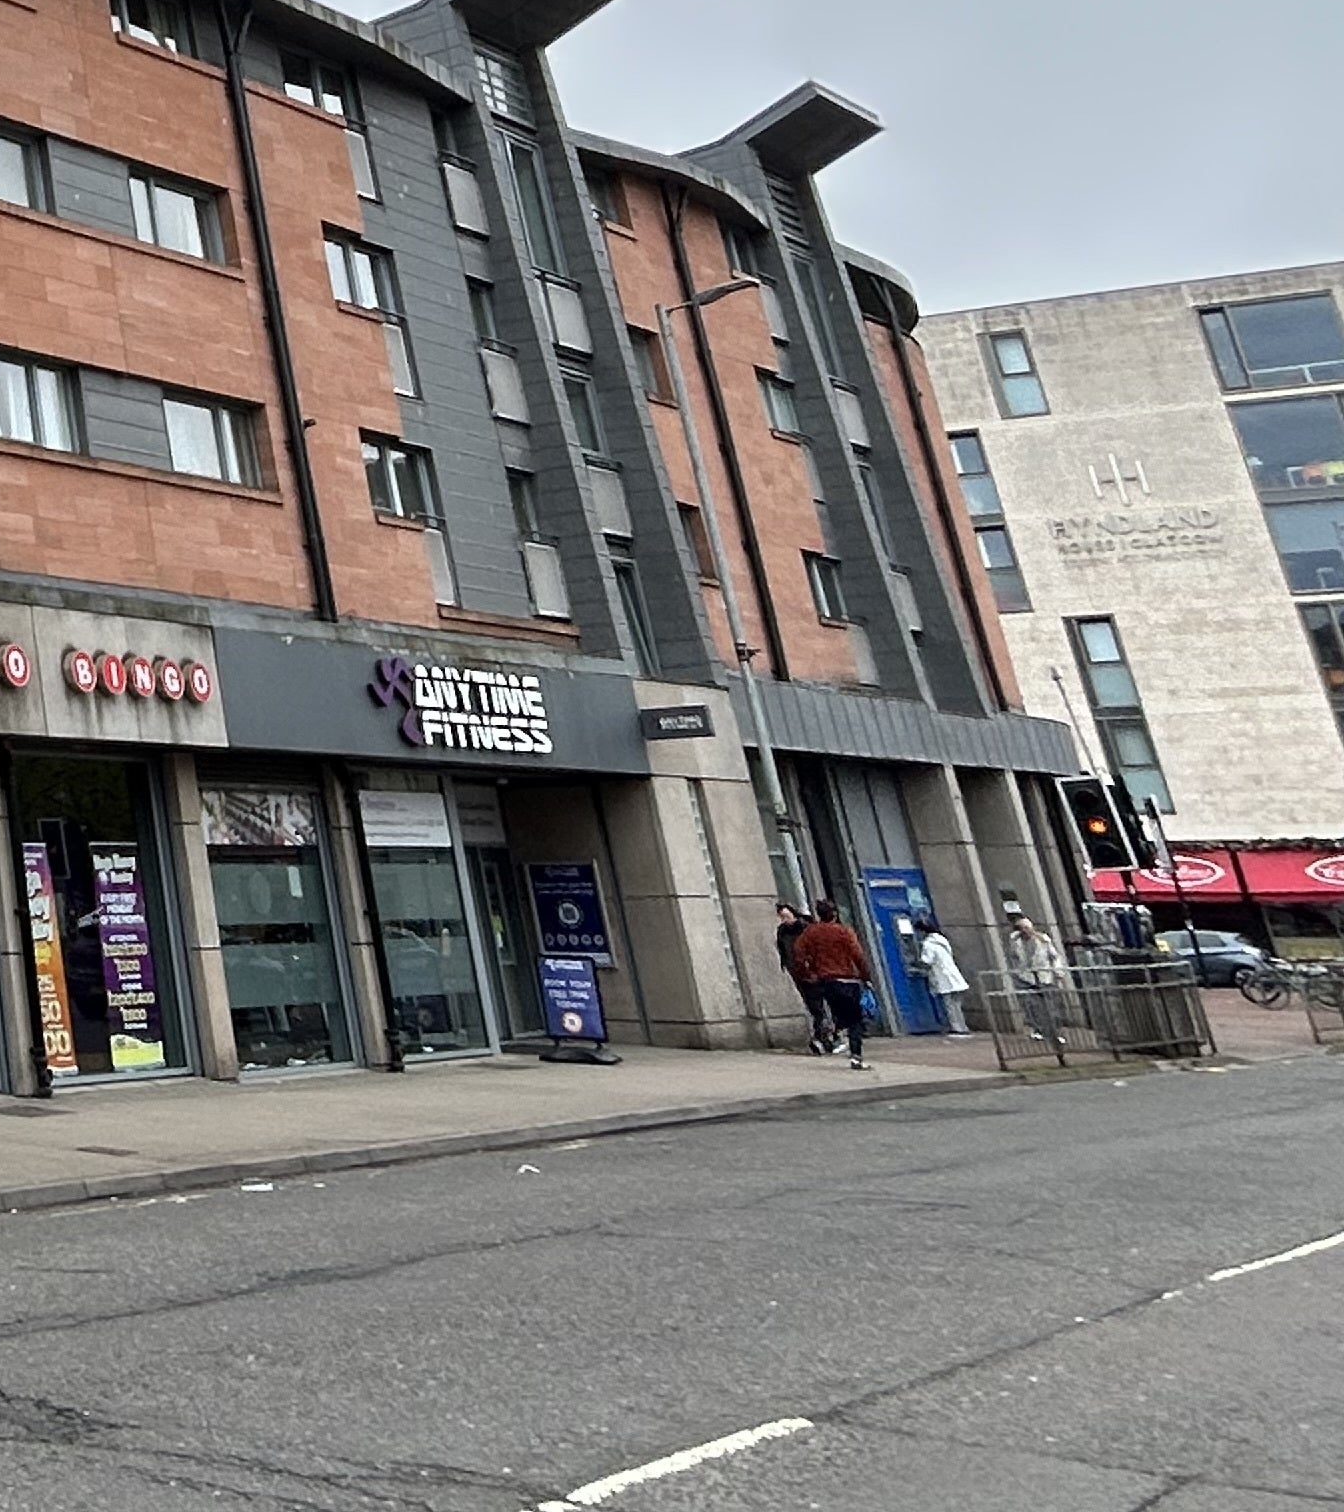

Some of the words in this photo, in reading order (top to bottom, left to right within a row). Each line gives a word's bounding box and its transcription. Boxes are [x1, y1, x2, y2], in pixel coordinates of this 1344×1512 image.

[75, 654, 210, 699] BINGO
[415, 664, 546, 717] ANYTIME
[422, 710, 553, 753] FITNESS
